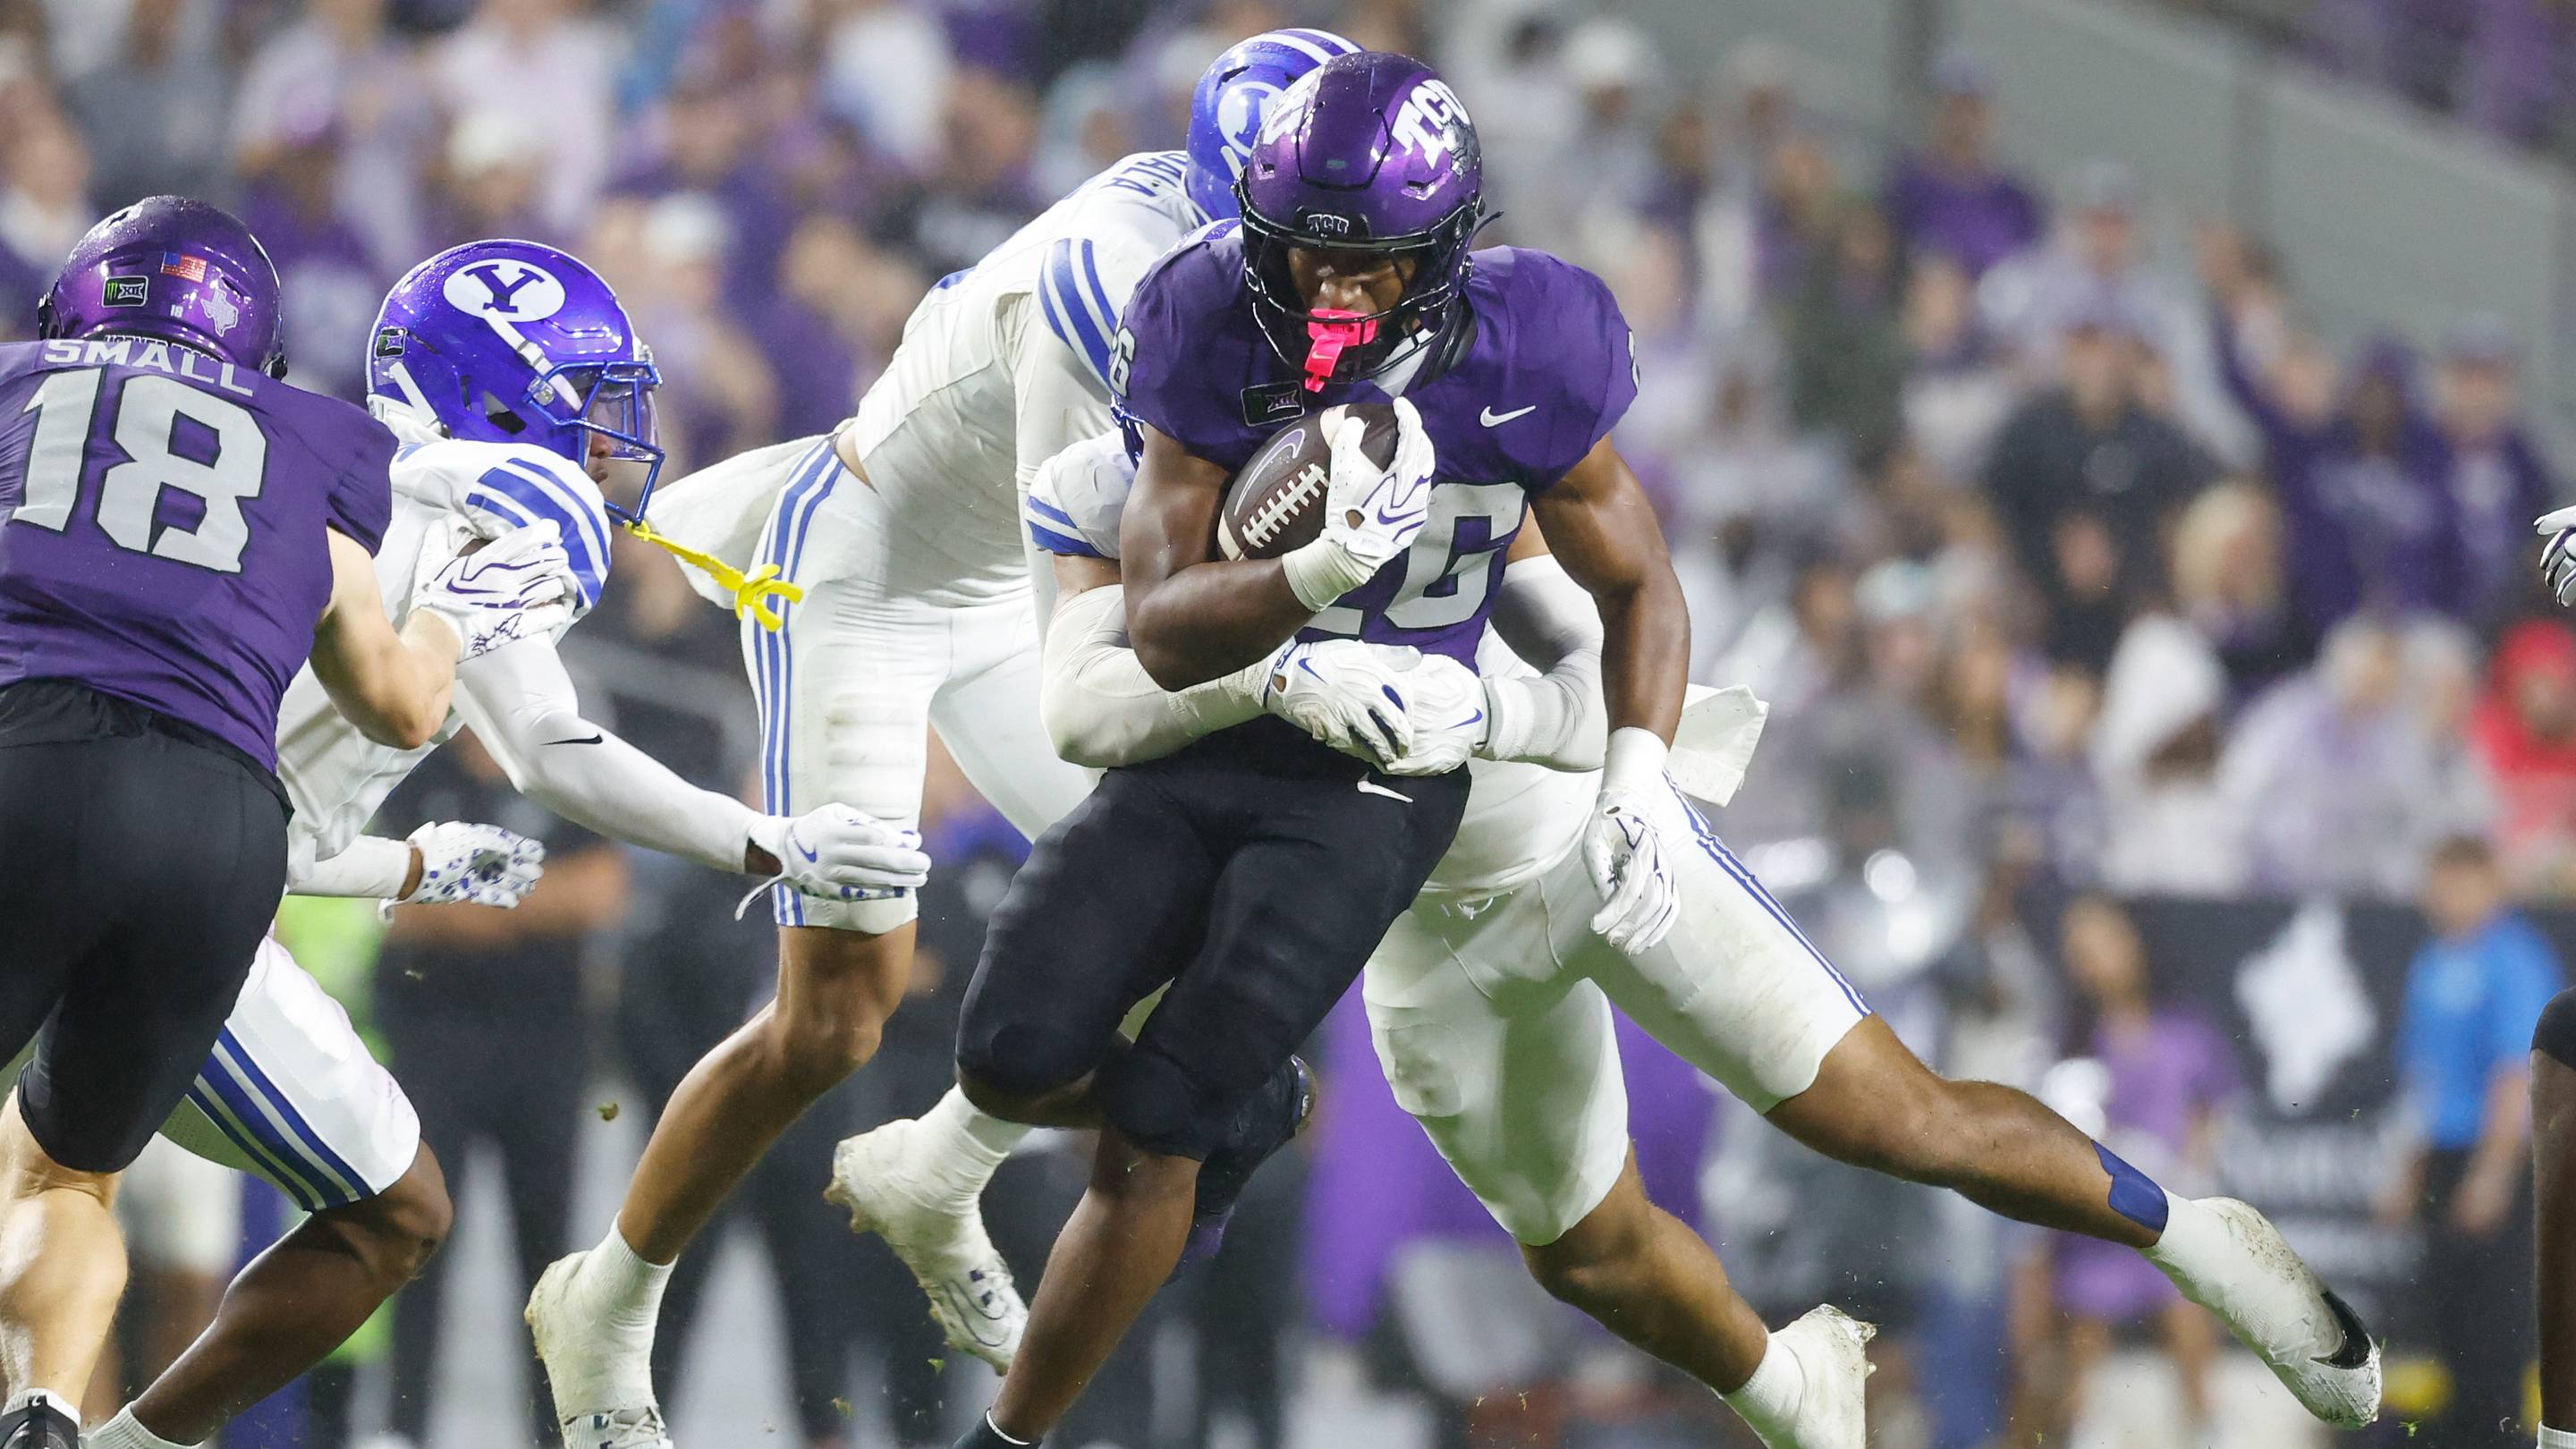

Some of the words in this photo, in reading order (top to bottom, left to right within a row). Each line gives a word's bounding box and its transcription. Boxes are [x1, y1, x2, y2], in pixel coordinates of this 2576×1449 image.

[1392, 79, 1471, 170] TCU
[1307, 214, 1350, 233] TCU
[170, 304, 184, 318] 18
[463, 264, 546, 313] Y
[44, 339, 254, 397] SMALL
[1109, 327, 1135, 397] 6
[10, 367, 267, 574] 18
